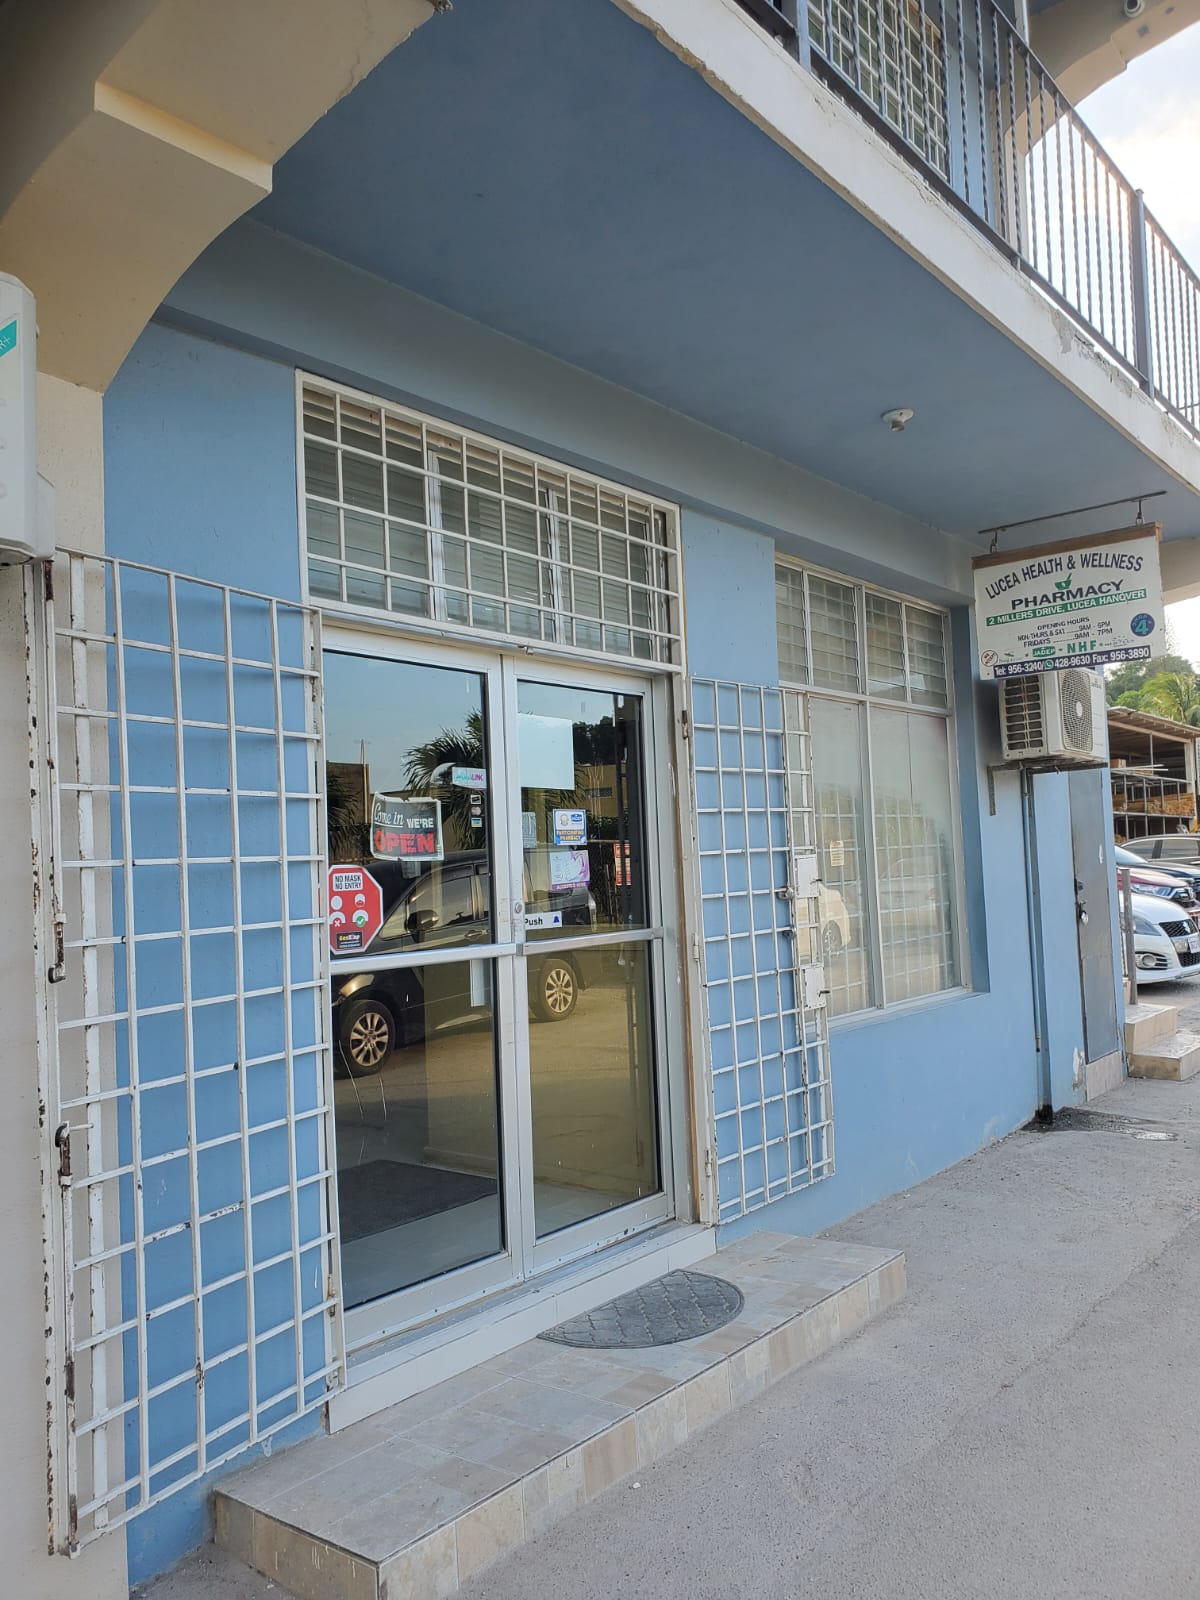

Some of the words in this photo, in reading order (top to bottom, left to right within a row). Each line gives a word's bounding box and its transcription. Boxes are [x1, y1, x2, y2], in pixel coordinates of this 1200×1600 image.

[985, 572, 1021, 600] LUCEA
[1021, 556, 1063, 581] HEALTH
[1066, 554, 1076, 570] &
[1080, 552, 1144, 572] WELLNESS
[1011, 578, 1124, 611] PHARMACY
[988, 616, 996, 626] 2
[997, 610, 1034, 624] MILLERS
[1066, 599, 1097, 612] LUCEA
[1099, 590, 1146, 606] HANOVER
[1037, 620, 1066, 631] OPENING
[1067, 616, 1090, 627] HOURS
[1135, 619, 1149, 635] 4
[1023, 638, 1051, 648] FRIDAYS
[1097, 627, 1113, 637] 7PM
[1054, 655, 1091, 668] 428-9630
[1109, 647, 1150, 661] 956-3890
[374, 802, 392, 824] Come
[393, 811, 404, 825] in
[406, 817, 434, 829] WE'RE
[374, 829, 435, 854] OPEN
[335, 875, 344, 883] NO
[344, 873, 362, 882] MASK
[335, 882, 343, 890] NO
[344, 882, 362, 890] ENTRY
[524, 917, 543, 926] Push
